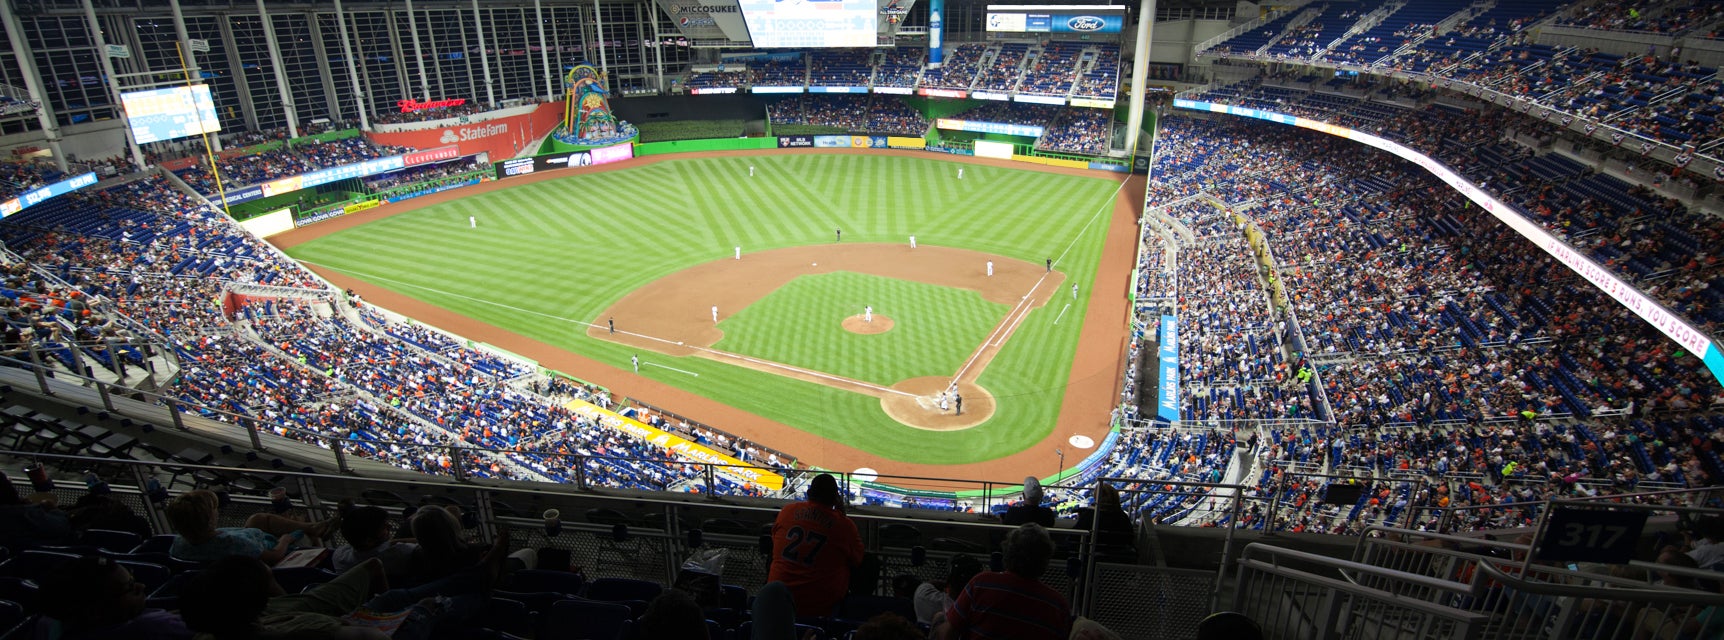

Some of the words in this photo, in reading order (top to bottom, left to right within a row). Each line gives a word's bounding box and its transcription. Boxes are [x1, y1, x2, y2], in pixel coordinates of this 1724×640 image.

[680, 5, 737, 13] MICCOSUKEE
[1074, 17, 1098, 30] Ford
[397, 98, 466, 113] Budweiser
[405, 149, 458, 166] CLEVELANDER
[1547, 241, 1554, 250] IF
[1554, 243, 1584, 272] MARLINS
[1585, 267, 1610, 289] SCORE
[1618, 287, 1644, 313] RUNS,
[1647, 305, 1668, 327] YOU
[1668, 321, 1706, 353] SCORE
[1163, 331, 1176, 353] MARLINS
[1166, 367, 1177, 380] PARK
[1162, 380, 1177, 411] MARLINS
[624, 422, 652, 438] PARK
[672, 442, 728, 467] MARLINS
[781, 525, 828, 566] 27
[1558, 522, 1628, 549] 317
